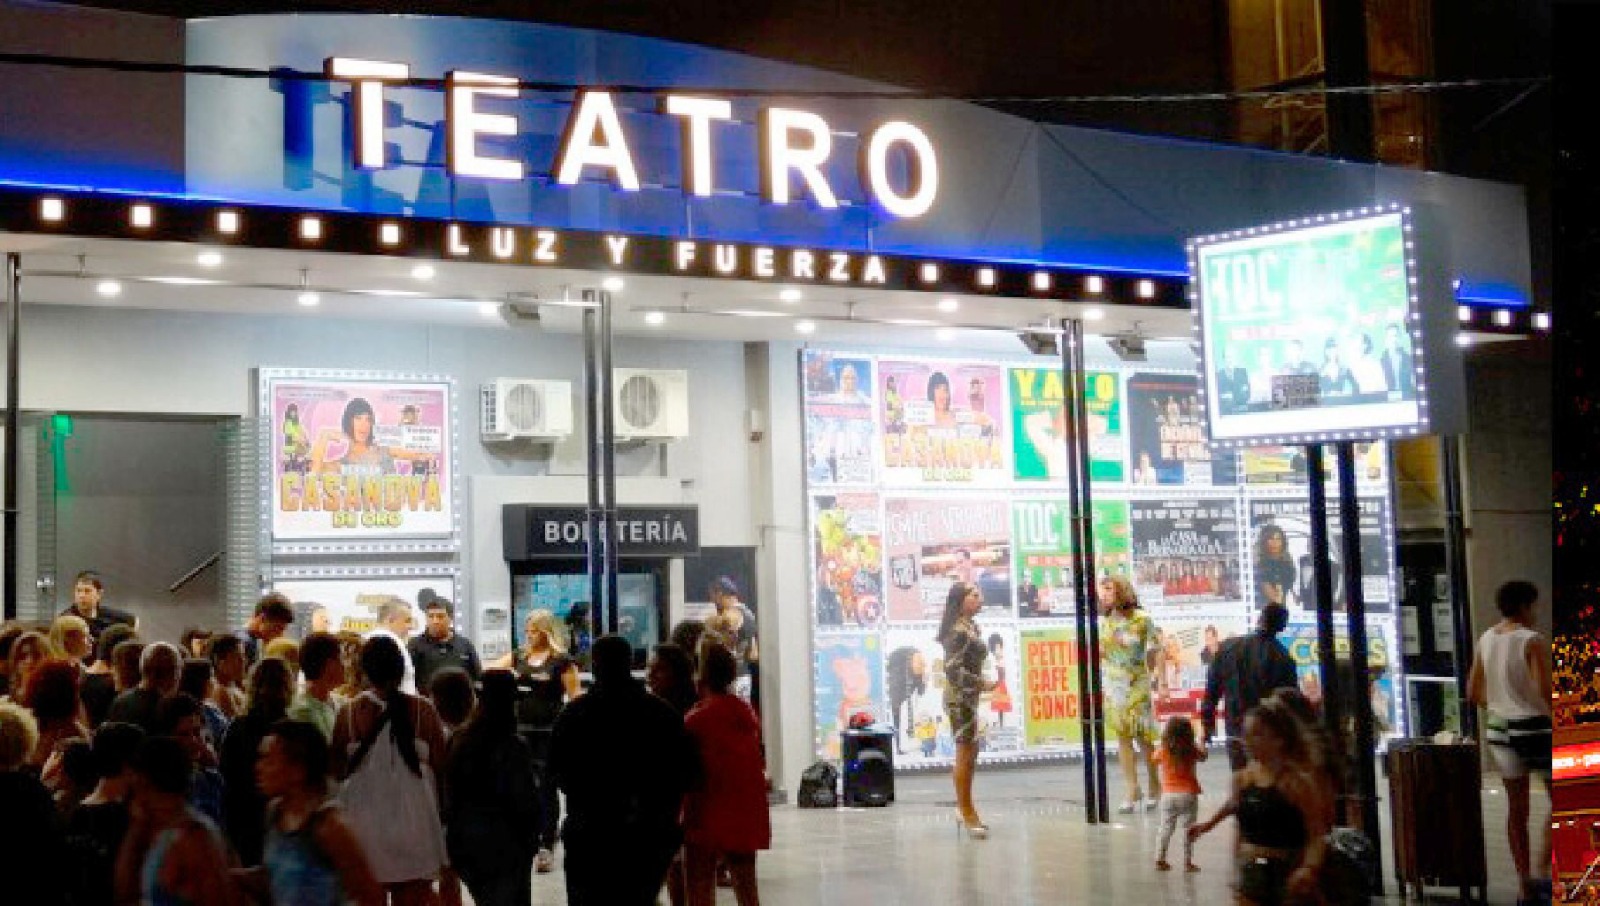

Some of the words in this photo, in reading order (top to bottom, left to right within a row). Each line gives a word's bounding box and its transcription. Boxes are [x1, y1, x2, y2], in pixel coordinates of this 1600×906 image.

[324, 56, 941, 220] TEATRO
[447, 223, 558, 263] LUZ
[605, 234, 629, 265] Y
[673, 241, 887, 284] FUERZA
[1013, 369, 1115, 401] YAO
[279, 475, 443, 513] CASANOVA
[360, 511, 403, 530] ORO
[1013, 501, 1059, 546] TOC
[1030, 693, 1077, 719] CONC
